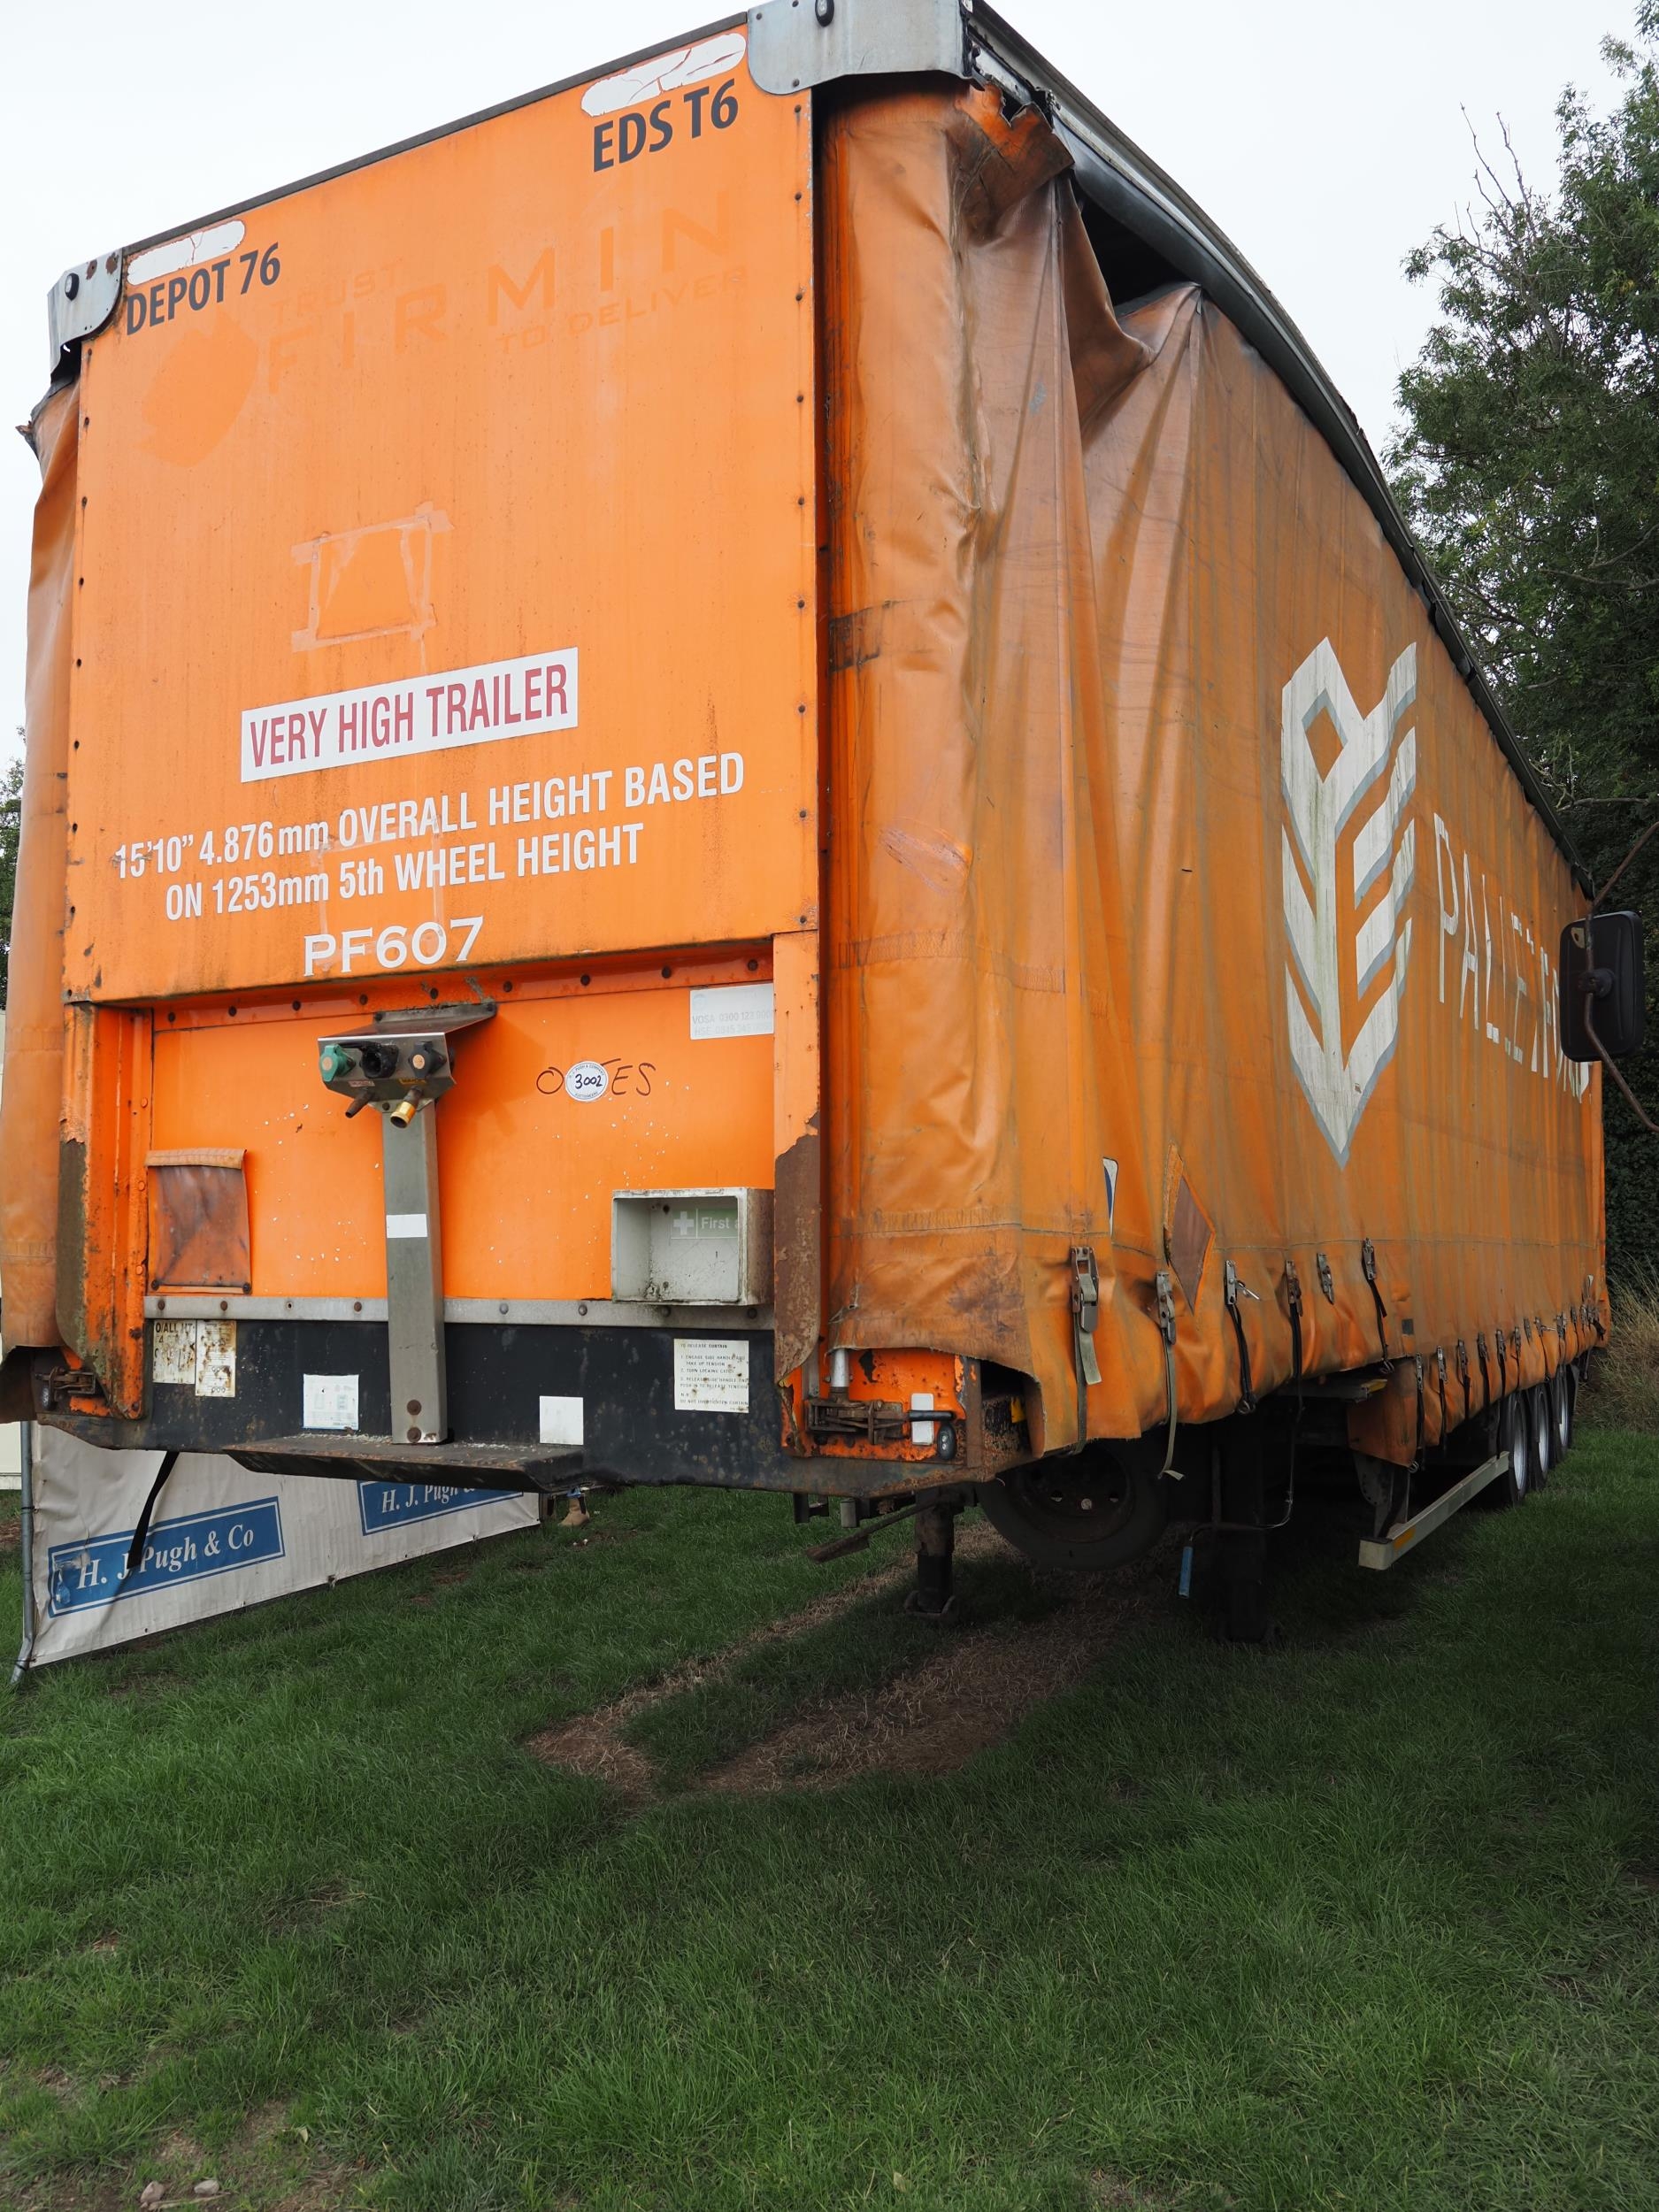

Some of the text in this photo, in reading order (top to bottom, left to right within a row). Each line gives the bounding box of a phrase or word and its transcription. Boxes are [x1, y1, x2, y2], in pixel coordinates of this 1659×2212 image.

[594, 78, 739, 173] EDS T6
[127, 242, 281, 335] DEPOT 76
[268, 189, 732, 396] FIRMIN
[274, 257, 403, 321] TRUST
[495, 263, 749, 356] TO DELIVER
[250, 664, 568, 768] VERY HIGH TRAILER
[339, 792, 478, 848] OVERALL
[488, 771, 613, 826] HEIGHT
[625, 752, 745, 808] BASED
[165, 823, 644, 921] ON 1253mm 5th WHEEL HEIGHT
[303, 916, 483, 977] PF607
[692, 1014, 715, 1025] VOSA
[574, 1073, 603, 1090] 3002
[701, 1217, 730, 1230] First
[382, 1489, 400, 1513] H.
[405, 1485, 419, 1508] J.
[78, 1559, 107, 1590] H.
[139, 1535, 197, 1573] Pugh
[204, 1530, 221, 1557] &
[228, 1524, 255, 1550] Co
